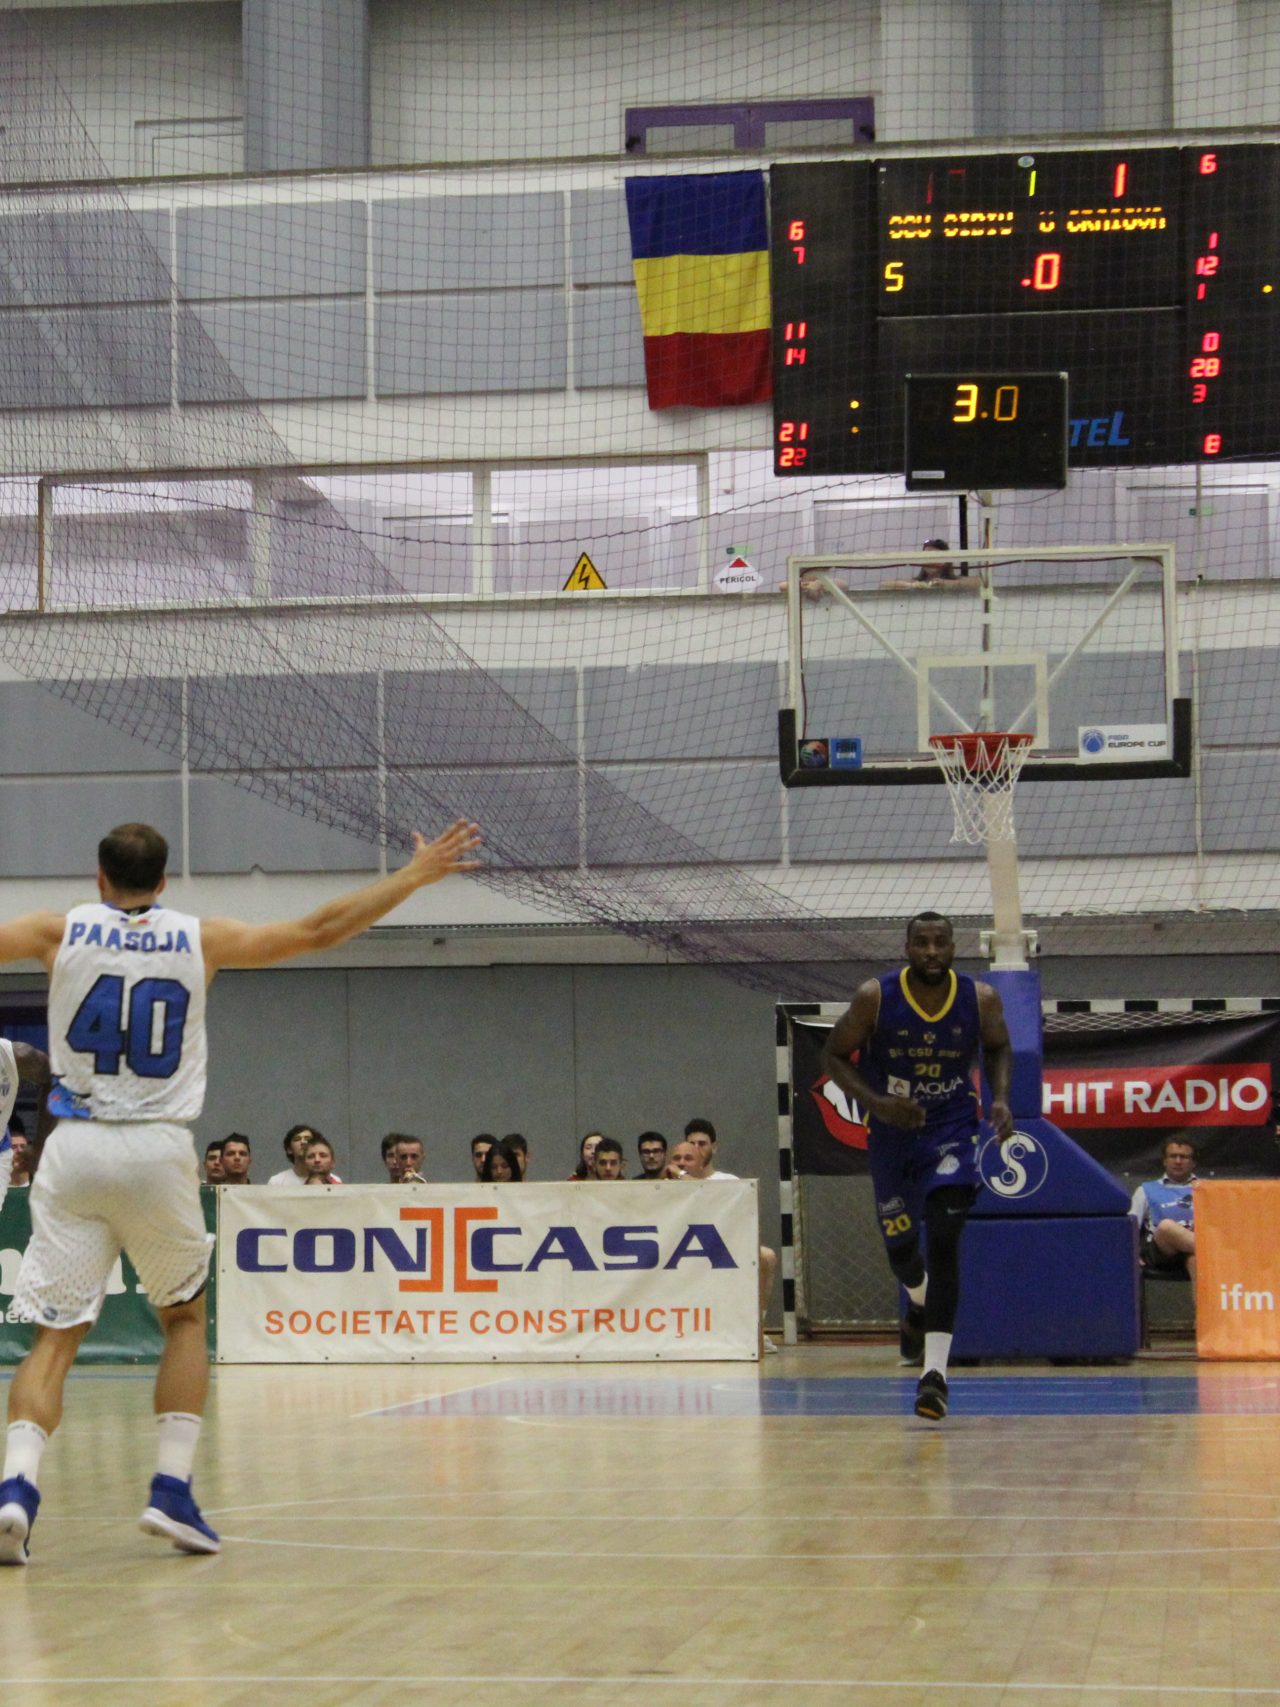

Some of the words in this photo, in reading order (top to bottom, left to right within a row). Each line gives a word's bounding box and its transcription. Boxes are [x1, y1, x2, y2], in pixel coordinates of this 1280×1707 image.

[1199, 153, 1218, 175] 6
[788, 220, 805, 241] 6
[792, 246, 806, 265] 7
[1195, 255, 1219, 275] 12
[785, 322, 807, 341] 11
[785, 348, 807, 366] 14
[1190, 358, 1221, 378] 28
[778, 422, 808, 443] 21
[779, 448, 808, 468] 22
[1108, 741, 1145, 749] EUROPE
[1148, 740, 1166, 748] CUP
[69, 921, 191, 954] PAASOJA
[65, 973, 191, 1079] 40
[1042, 1081, 1113, 1114] HIT
[1124, 1077, 1268, 1114] RADIO
[882, 1214, 912, 1236] 20
[1220, 1282, 1274, 1311] ifm
[265, 1310, 459, 1335] SOCIETATE
